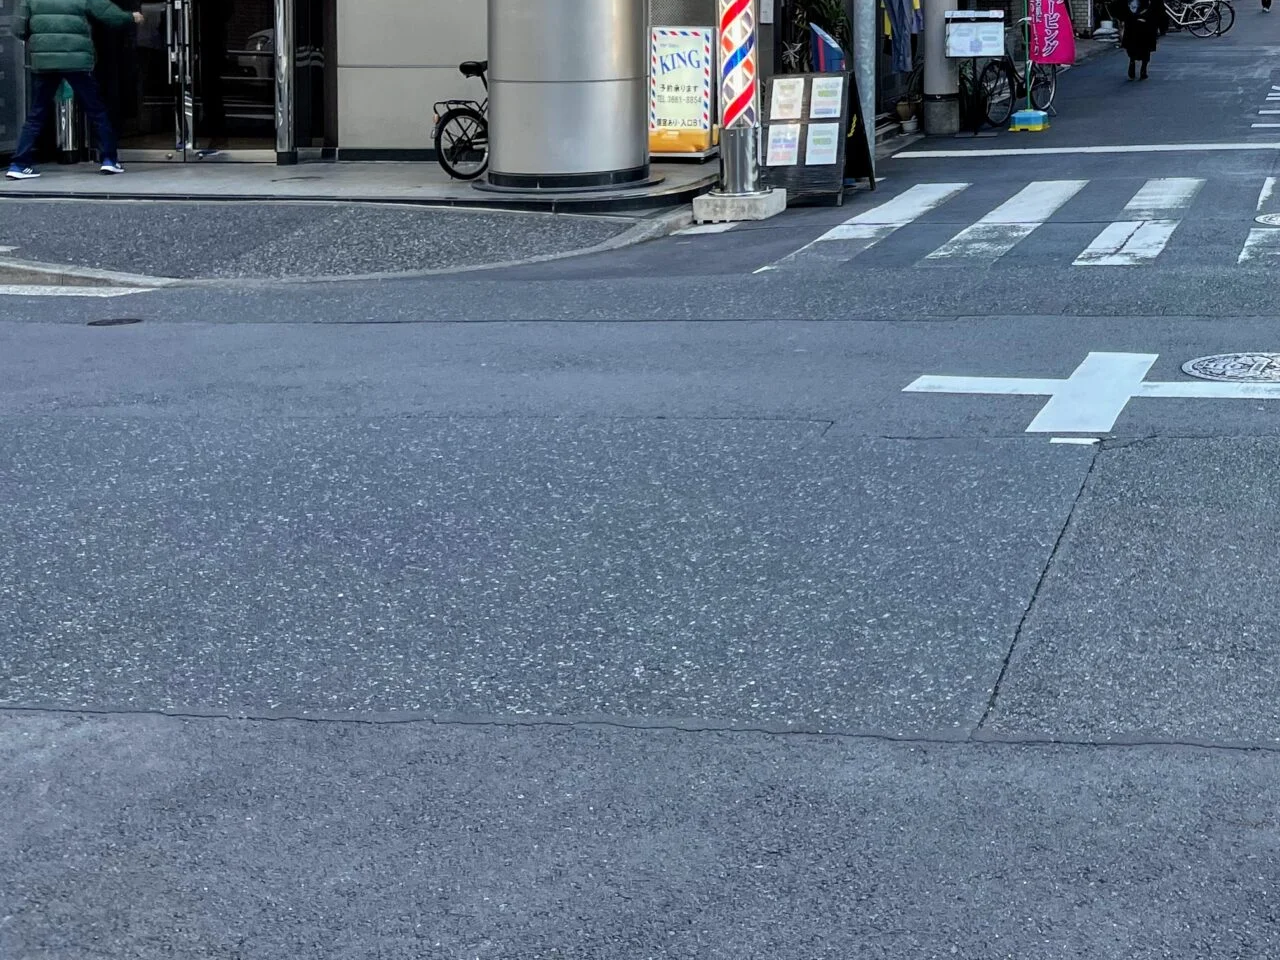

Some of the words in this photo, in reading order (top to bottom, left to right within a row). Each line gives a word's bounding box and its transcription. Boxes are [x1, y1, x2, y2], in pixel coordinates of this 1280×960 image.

[660, 49, 701, 75] KING
[660, 84, 699, 93] 予約承ります
